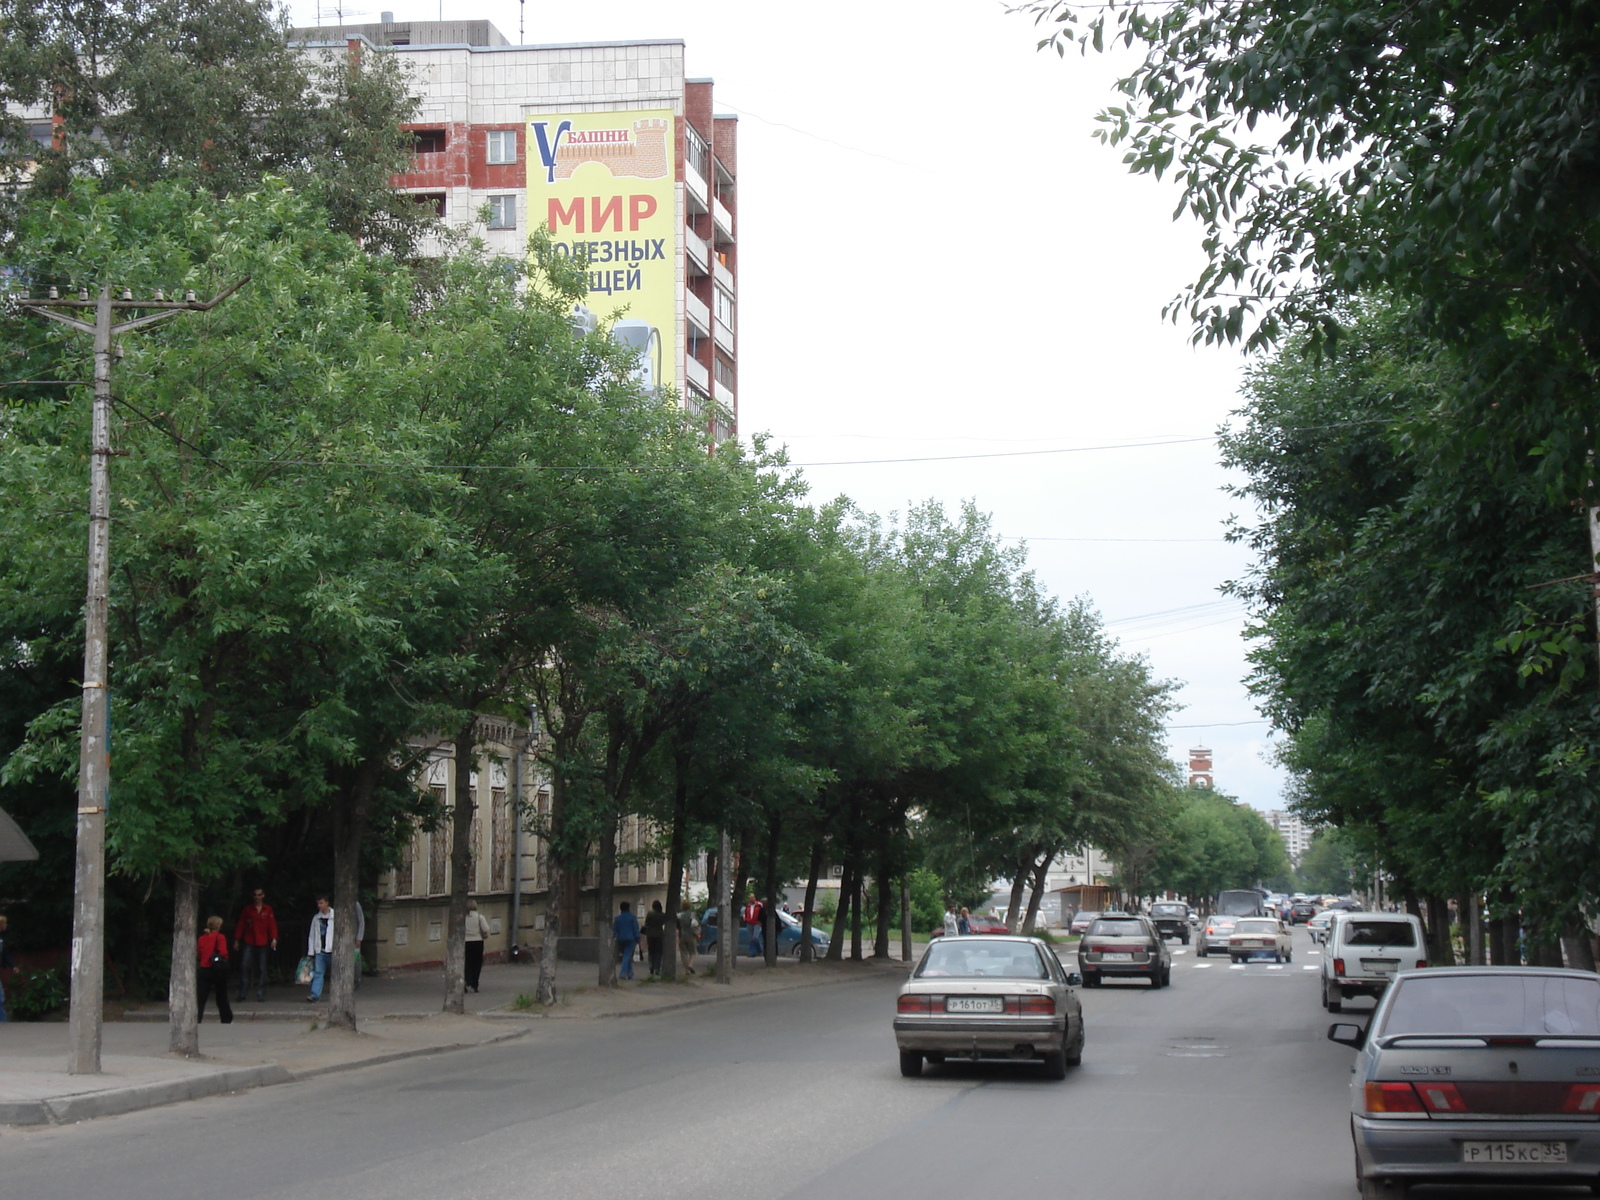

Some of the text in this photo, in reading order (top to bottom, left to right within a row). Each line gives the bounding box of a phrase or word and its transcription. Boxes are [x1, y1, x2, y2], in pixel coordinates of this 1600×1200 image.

[567, 130, 629, 144] БАШНИ
[548, 194, 658, 234] МИР
[577, 262, 641, 296] ЩЕЙ
